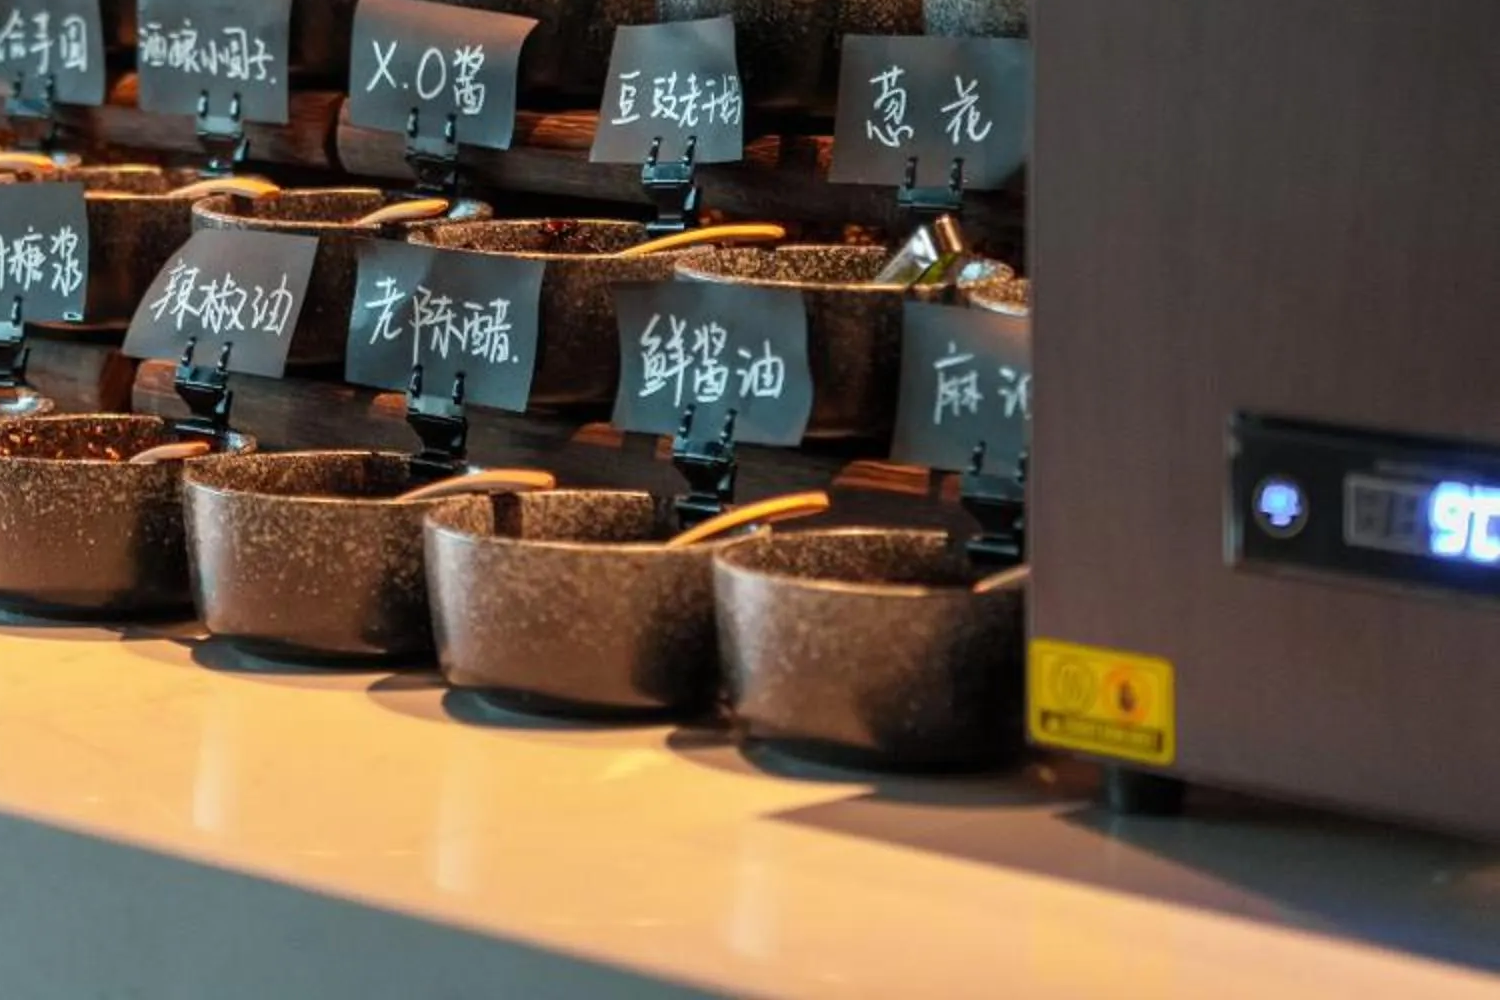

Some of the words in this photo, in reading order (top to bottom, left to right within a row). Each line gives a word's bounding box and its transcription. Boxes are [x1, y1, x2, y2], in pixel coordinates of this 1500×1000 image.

[866, 65, 993, 147] 葱花
[150, 257, 293, 336] 辣椒油
[638, 313, 785, 407] 鲜酱油
